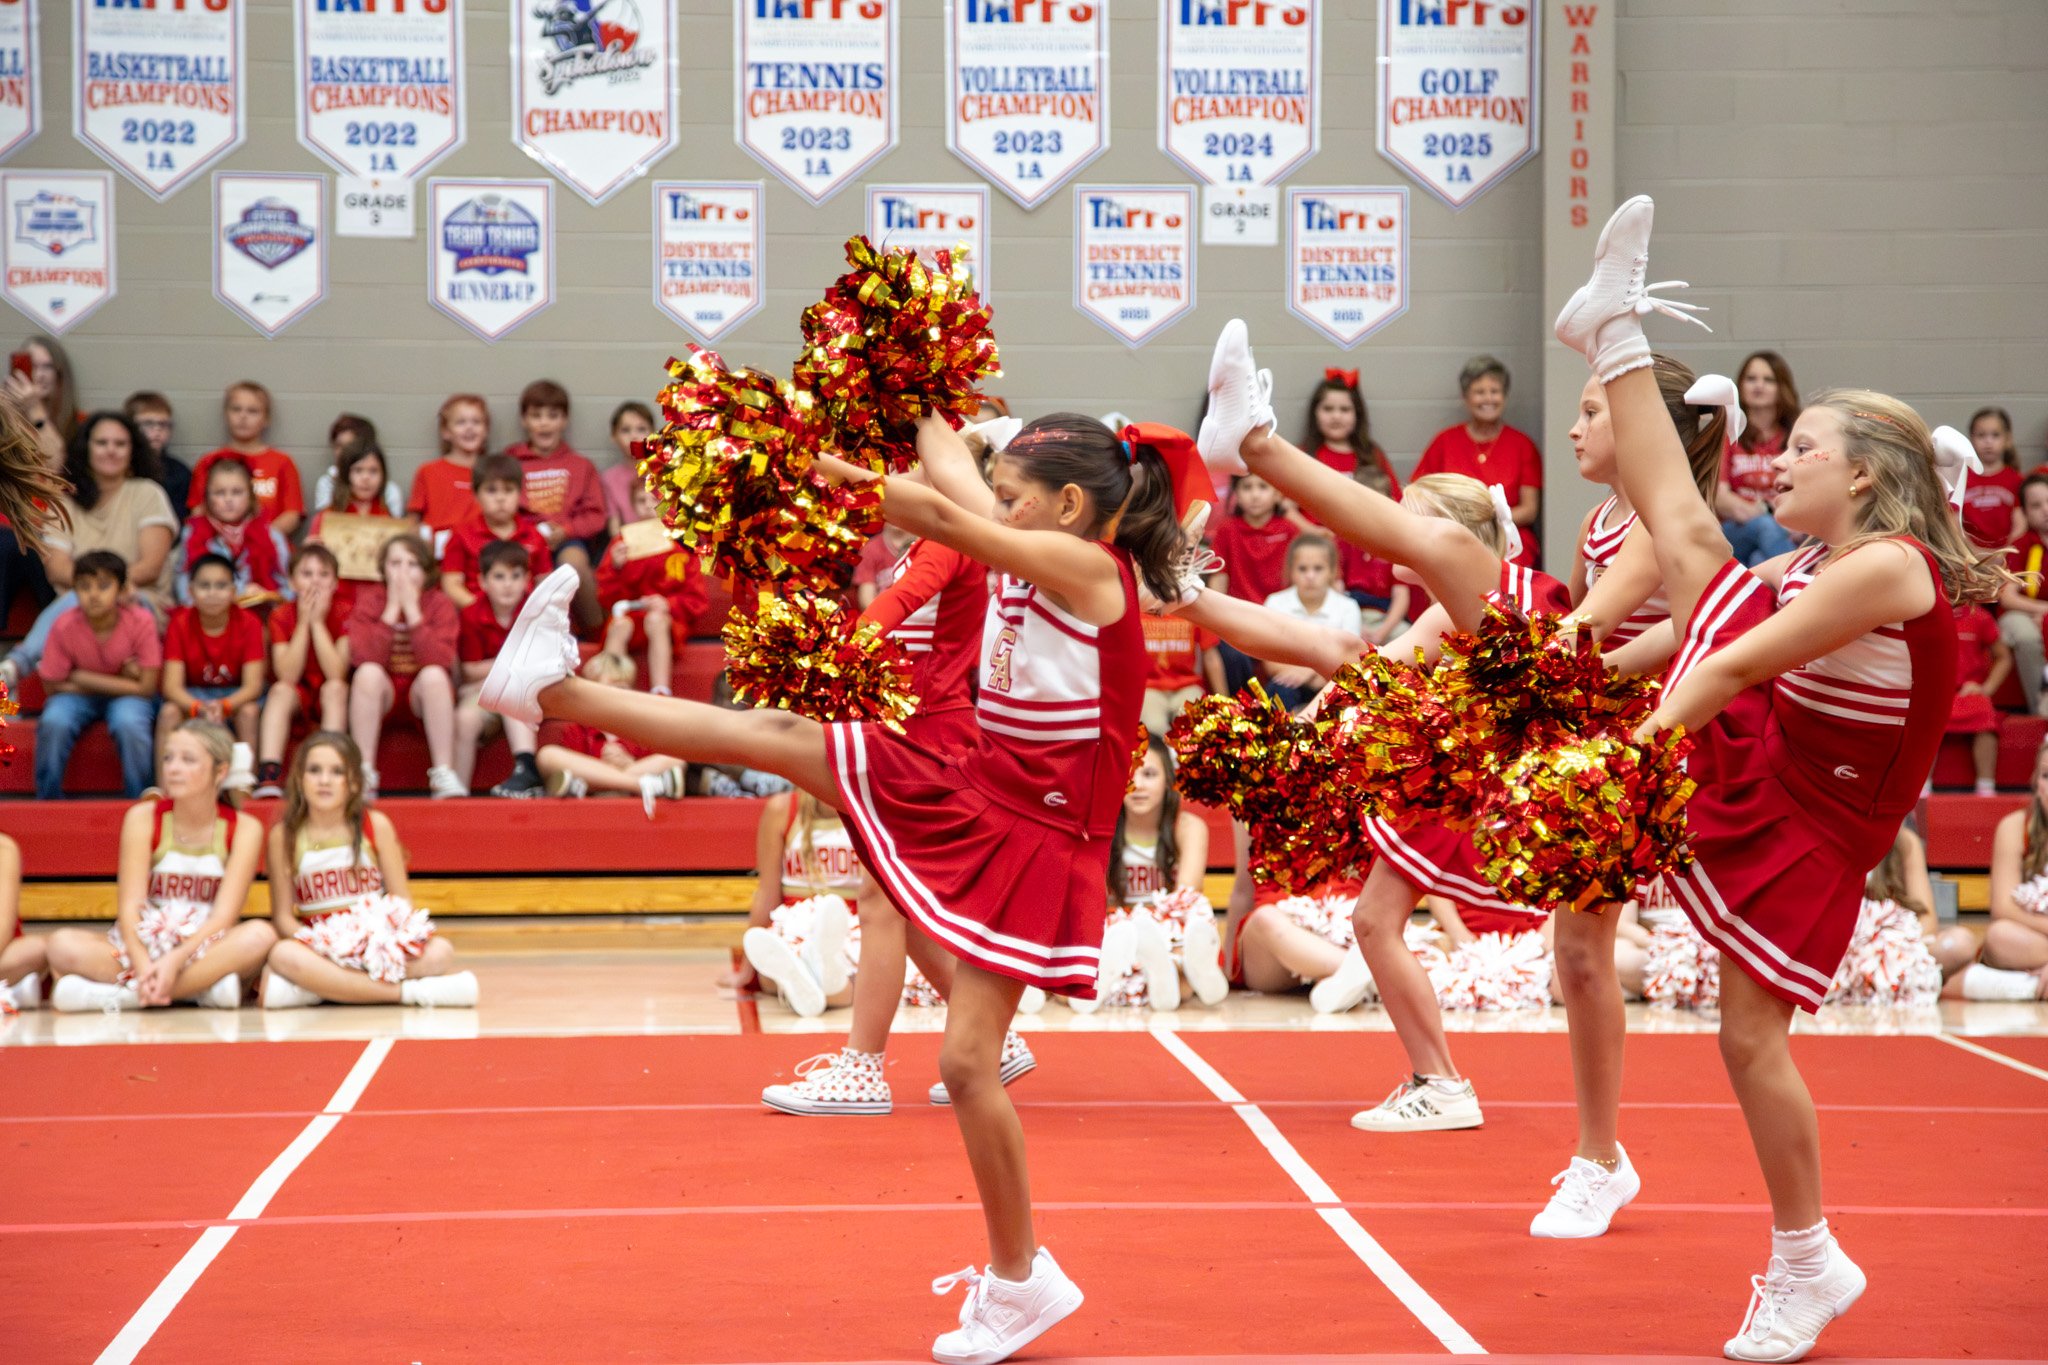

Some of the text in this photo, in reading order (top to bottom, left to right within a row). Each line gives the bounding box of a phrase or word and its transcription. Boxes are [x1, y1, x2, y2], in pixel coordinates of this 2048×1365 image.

[88, 51, 230, 83] BASKETBALL
[310, 55, 449, 84] BASKETBALL
[748, 62, 884, 90] TENNIS
[961, 66, 1097, 92] VOLLEYBALL
[1174, 69, 1308, 95] VOLLEYBALL
[1421, 68, 1499, 95] GOLF
[87, 80, 230, 115] CHAMPIONS
[310, 83, 449, 115] CHAMPIONS
[749, 89, 885, 120] CHAMPION
[960, 93, 1095, 122] CHAMPION
[1173, 95, 1306, 125] CHAMPION
[1391, 96, 1528, 126] CHAMPION
[1564, 5, 1598, 229] WARRIORS
[122, 118, 196, 144] 2022
[345, 121, 418, 146] 2022
[526, 107, 664, 138] CHAMPION
[782, 127, 851, 151] 2023
[993, 130, 1062, 154] 2023
[1204, 132, 1273, 157] 2024
[1424, 132, 1492, 157] 2025
[147, 151, 175, 170] 1A
[369, 152, 397, 171] 1A
[804, 158, 831, 176] 1A
[1016, 161, 1043, 179] 1A
[1226, 163, 1253, 182] 1A
[1445, 163, 1472, 183] 1A
[343, 193, 407, 210] GRADE
[1209, 203, 1271, 218] GRADE
[664, 242, 752, 258] DISTRICT
[1088, 245, 1181, 261] DISTRICT
[1301, 248, 1394, 263] DISTRICT
[7, 268, 104, 288] CHAMPION
[664, 260, 753, 277] TENNIS
[1088, 263, 1182, 280] TENNIS
[1302, 265, 1395, 282] TENNIS
[663, 280, 751, 298] CHAMPION
[1087, 283, 1181, 301] CHAMPION
